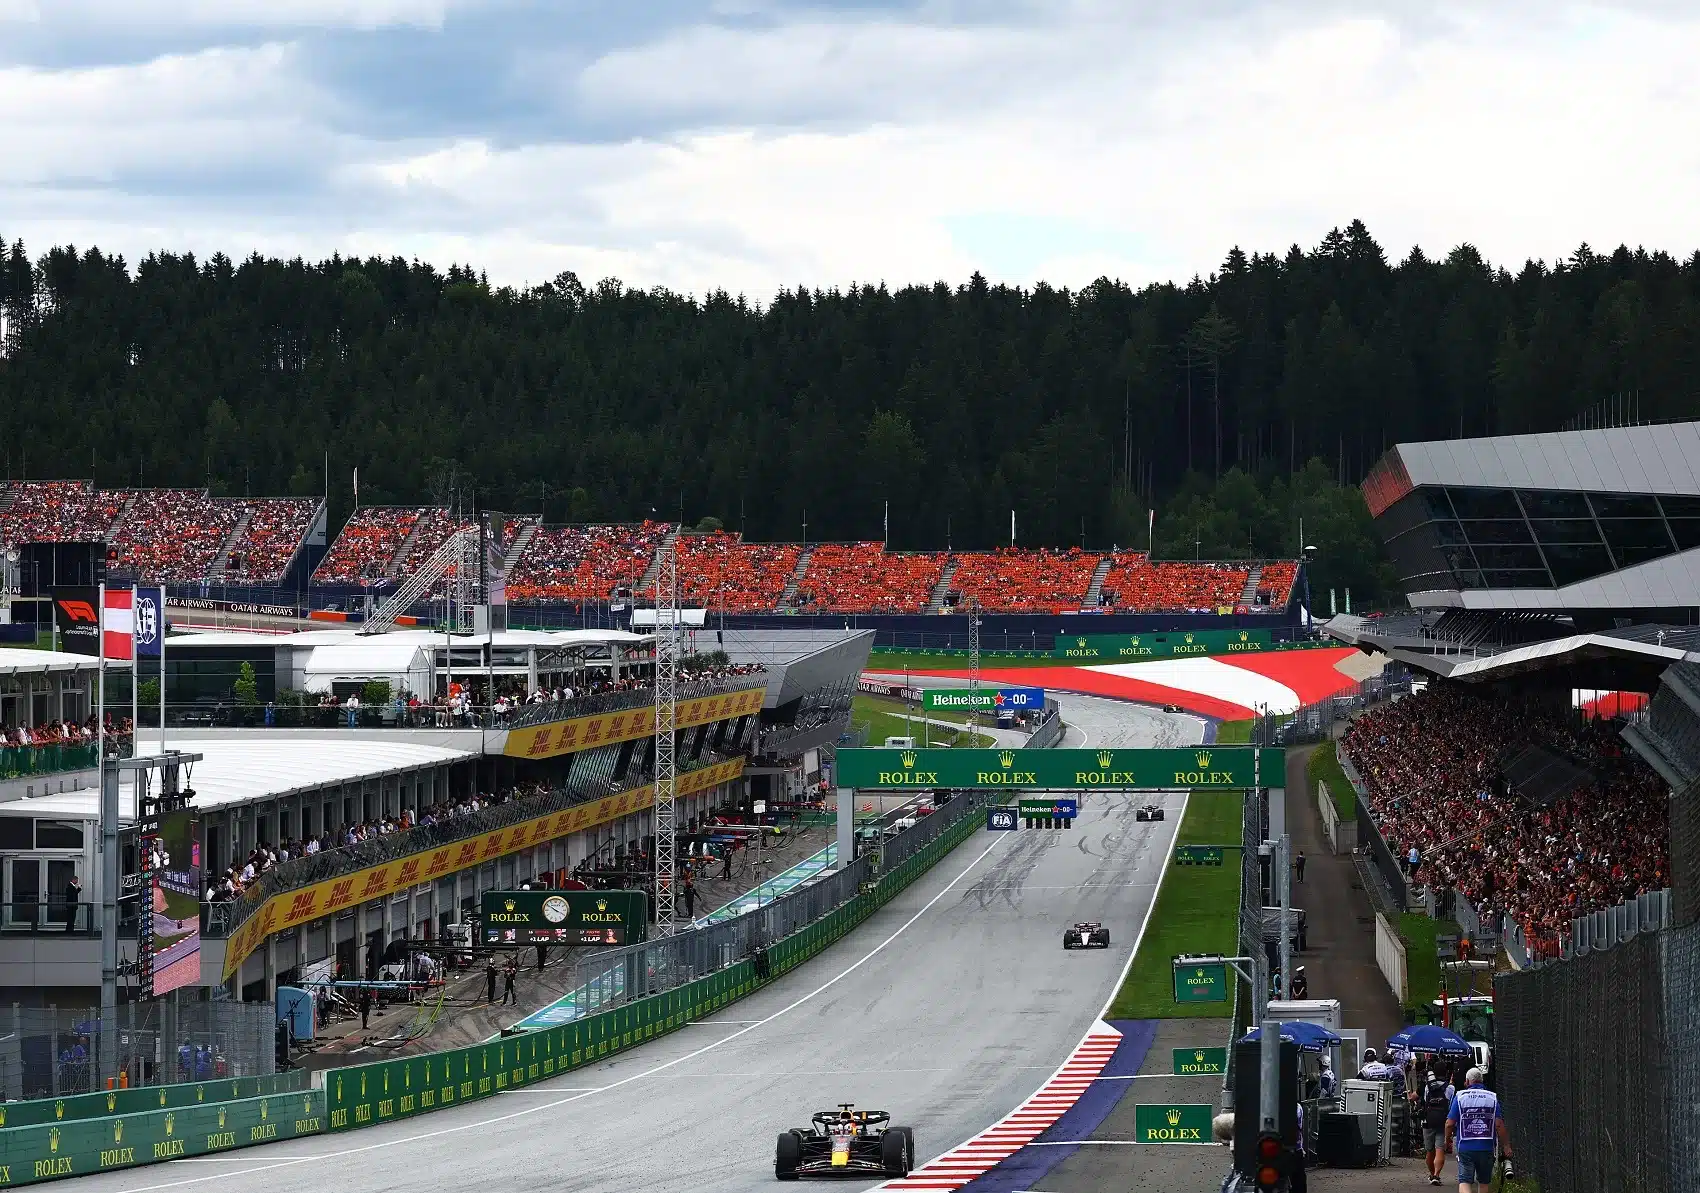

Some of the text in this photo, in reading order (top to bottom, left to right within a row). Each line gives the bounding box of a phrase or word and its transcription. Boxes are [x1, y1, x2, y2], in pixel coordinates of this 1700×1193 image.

[180, 600, 214, 608] AIRWAYS
[230, 604, 293, 616] QATAR AIRWAYS
[1228, 642, 1261, 650] ROLEX
[933, 694, 990, 706] Heineken
[878, 772, 938, 784] ROLEX
[976, 772, 1036, 784] ROLEX
[1075, 772, 1135, 784] ROLEX
[1174, 772, 1234, 784] ROLEX
[490, 914, 530, 922] ROLEX
[582, 914, 622, 922] ROLEX
[1181, 1063, 1219, 1073] ROLEX
[1367, 1093, 1375, 1102] B
[295, 1118, 320, 1133] ROLEX
[251, 1124, 276, 1140] ROLEX
[1147, 1128, 1201, 1139] ROLEX
[207, 1132, 236, 1149] ROLEX
[154, 1140, 184, 1158] ROLEX
[101, 1148, 134, 1167] ROLEX
[35, 1157, 72, 1177] ROLEX
